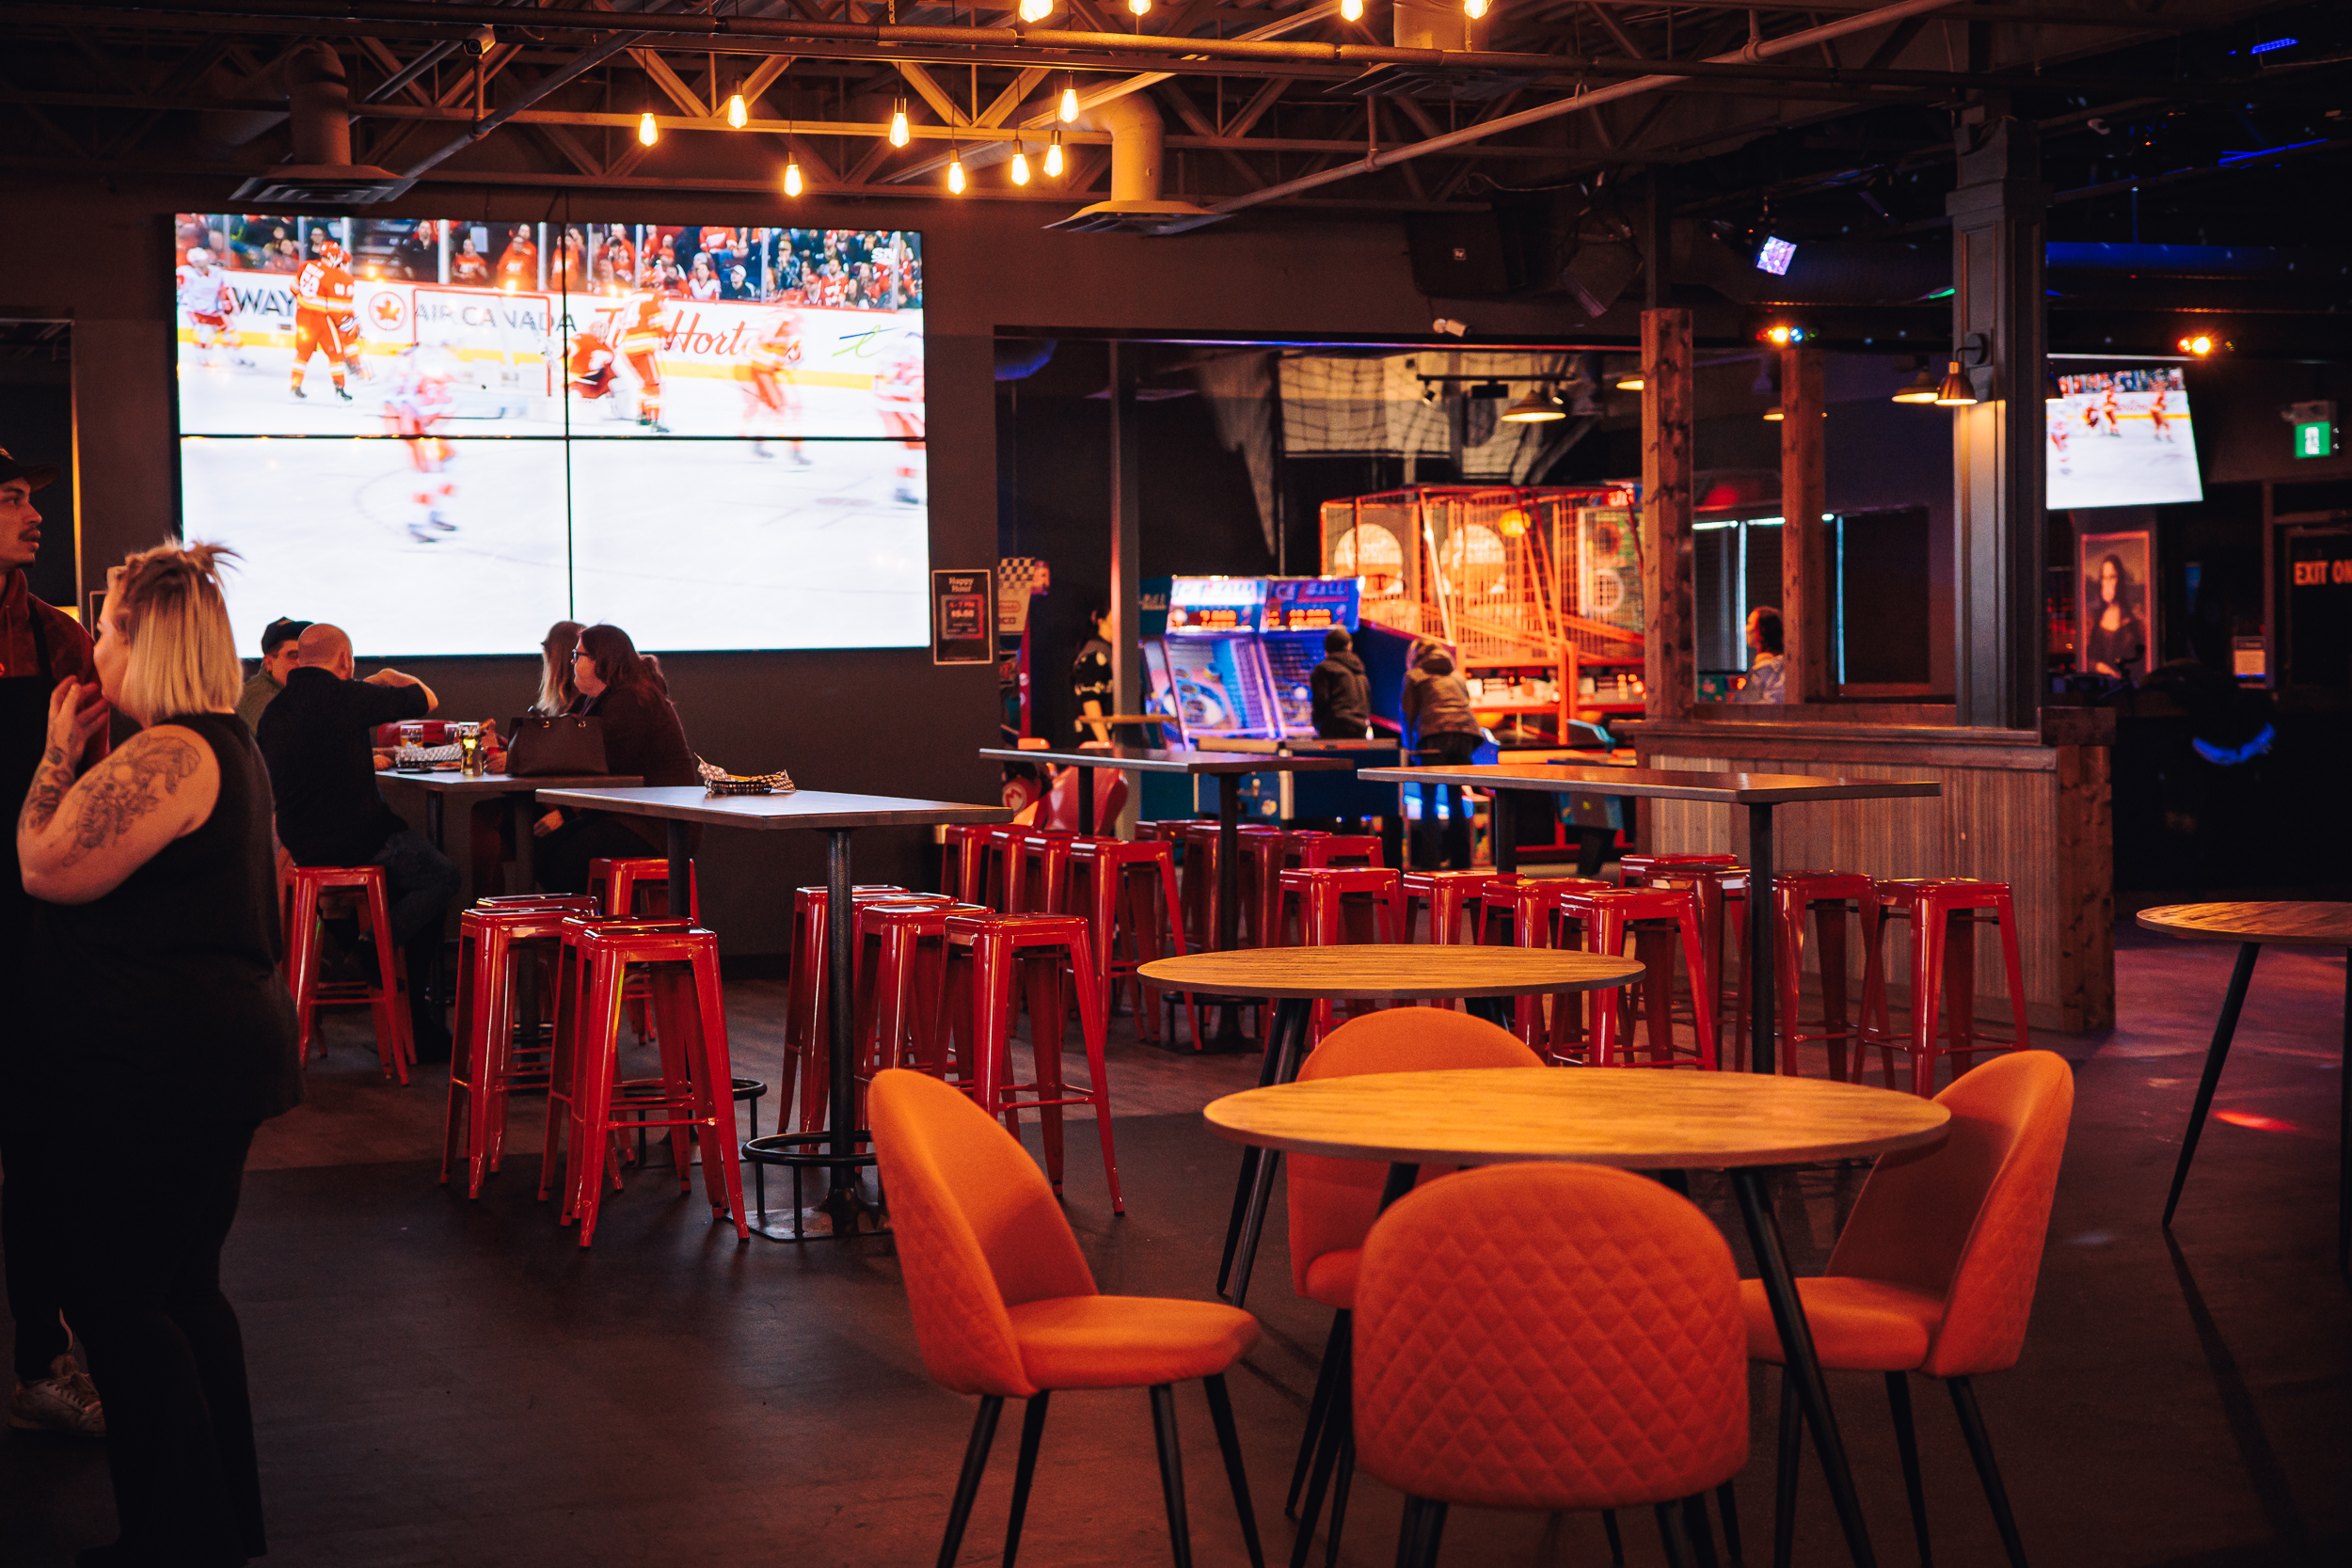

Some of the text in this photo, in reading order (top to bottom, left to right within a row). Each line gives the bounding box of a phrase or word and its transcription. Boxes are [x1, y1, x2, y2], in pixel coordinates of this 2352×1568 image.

[231, 286, 296, 317] WAY
[415, 304, 578, 332] AIR CANADA
[948, 577, 974, 586] Happy
[2295, 561, 2328, 585] EXIT
